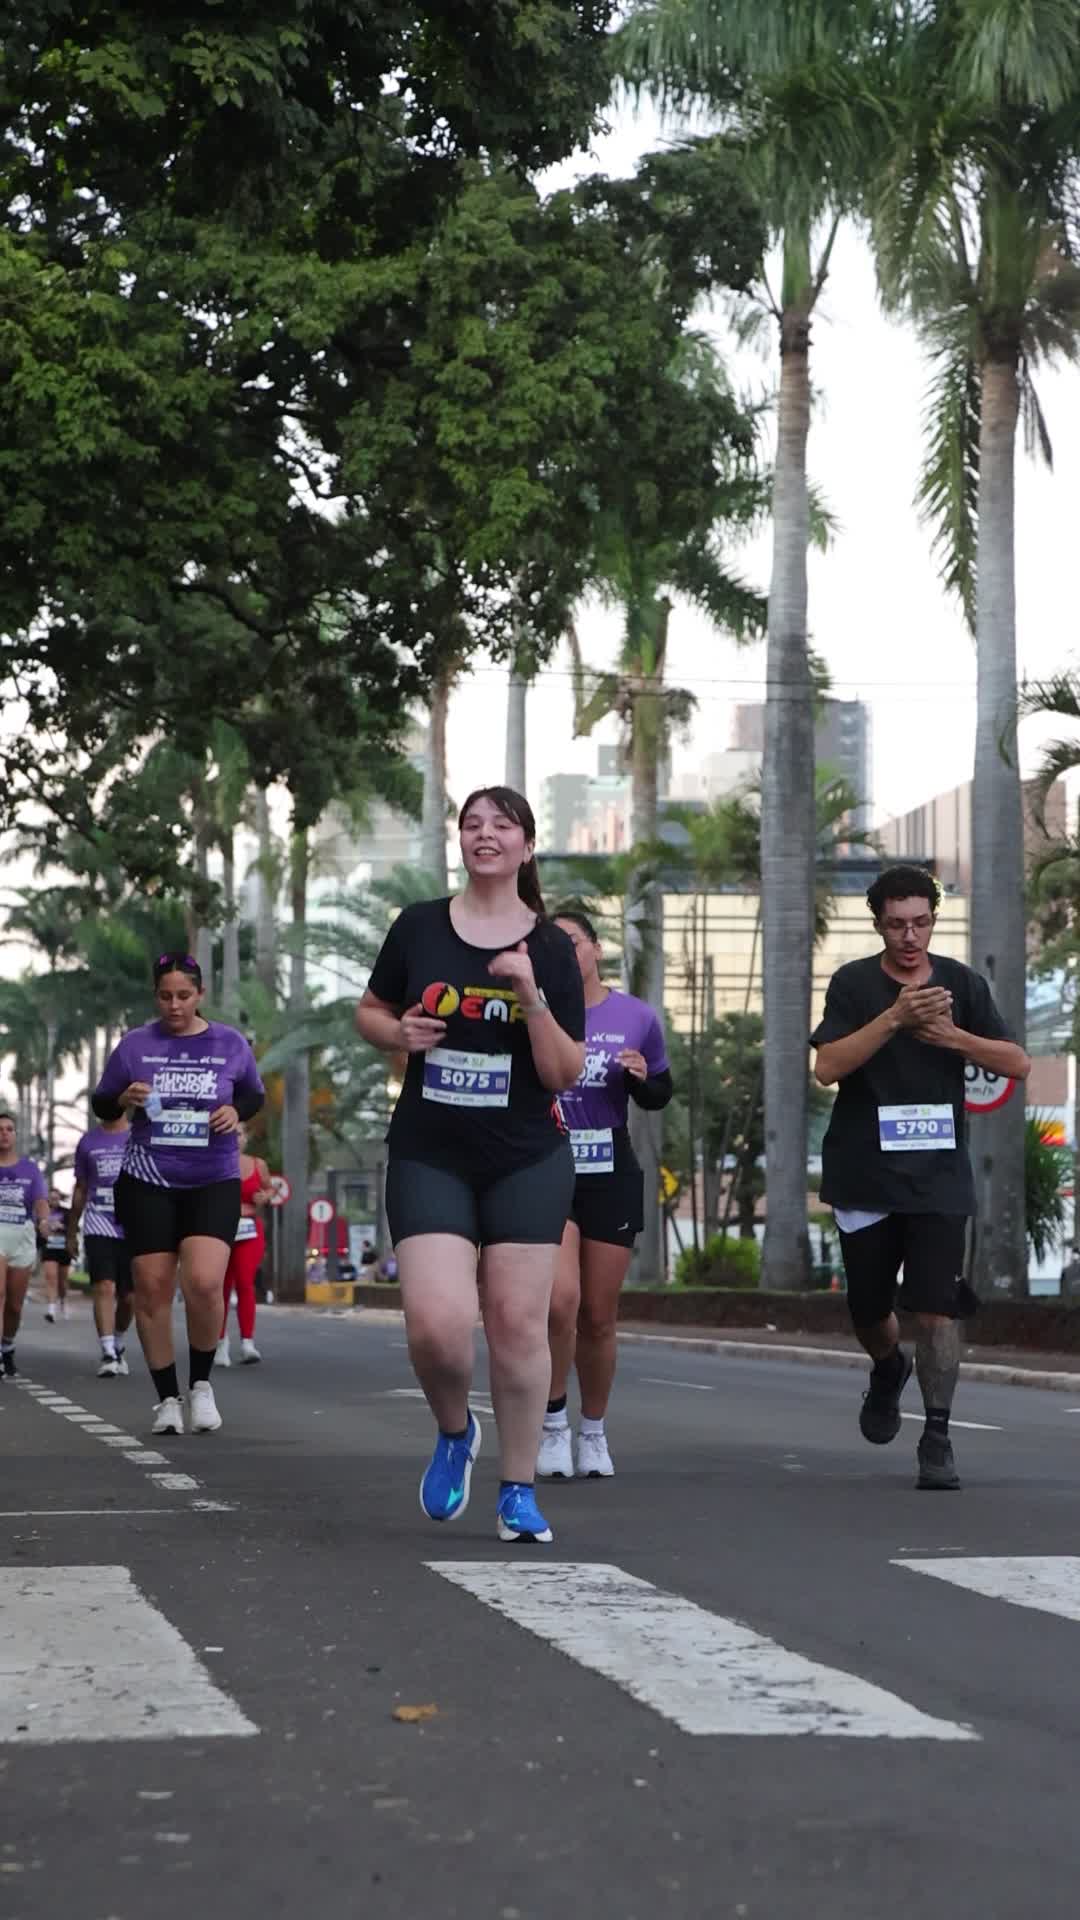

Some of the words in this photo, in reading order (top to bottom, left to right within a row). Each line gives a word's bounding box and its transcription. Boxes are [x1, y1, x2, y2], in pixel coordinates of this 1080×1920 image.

[441, 1069, 490, 1089] 5075
[162, 1123, 197, 1135] 6074
[896, 1120, 938, 1135] 5790
